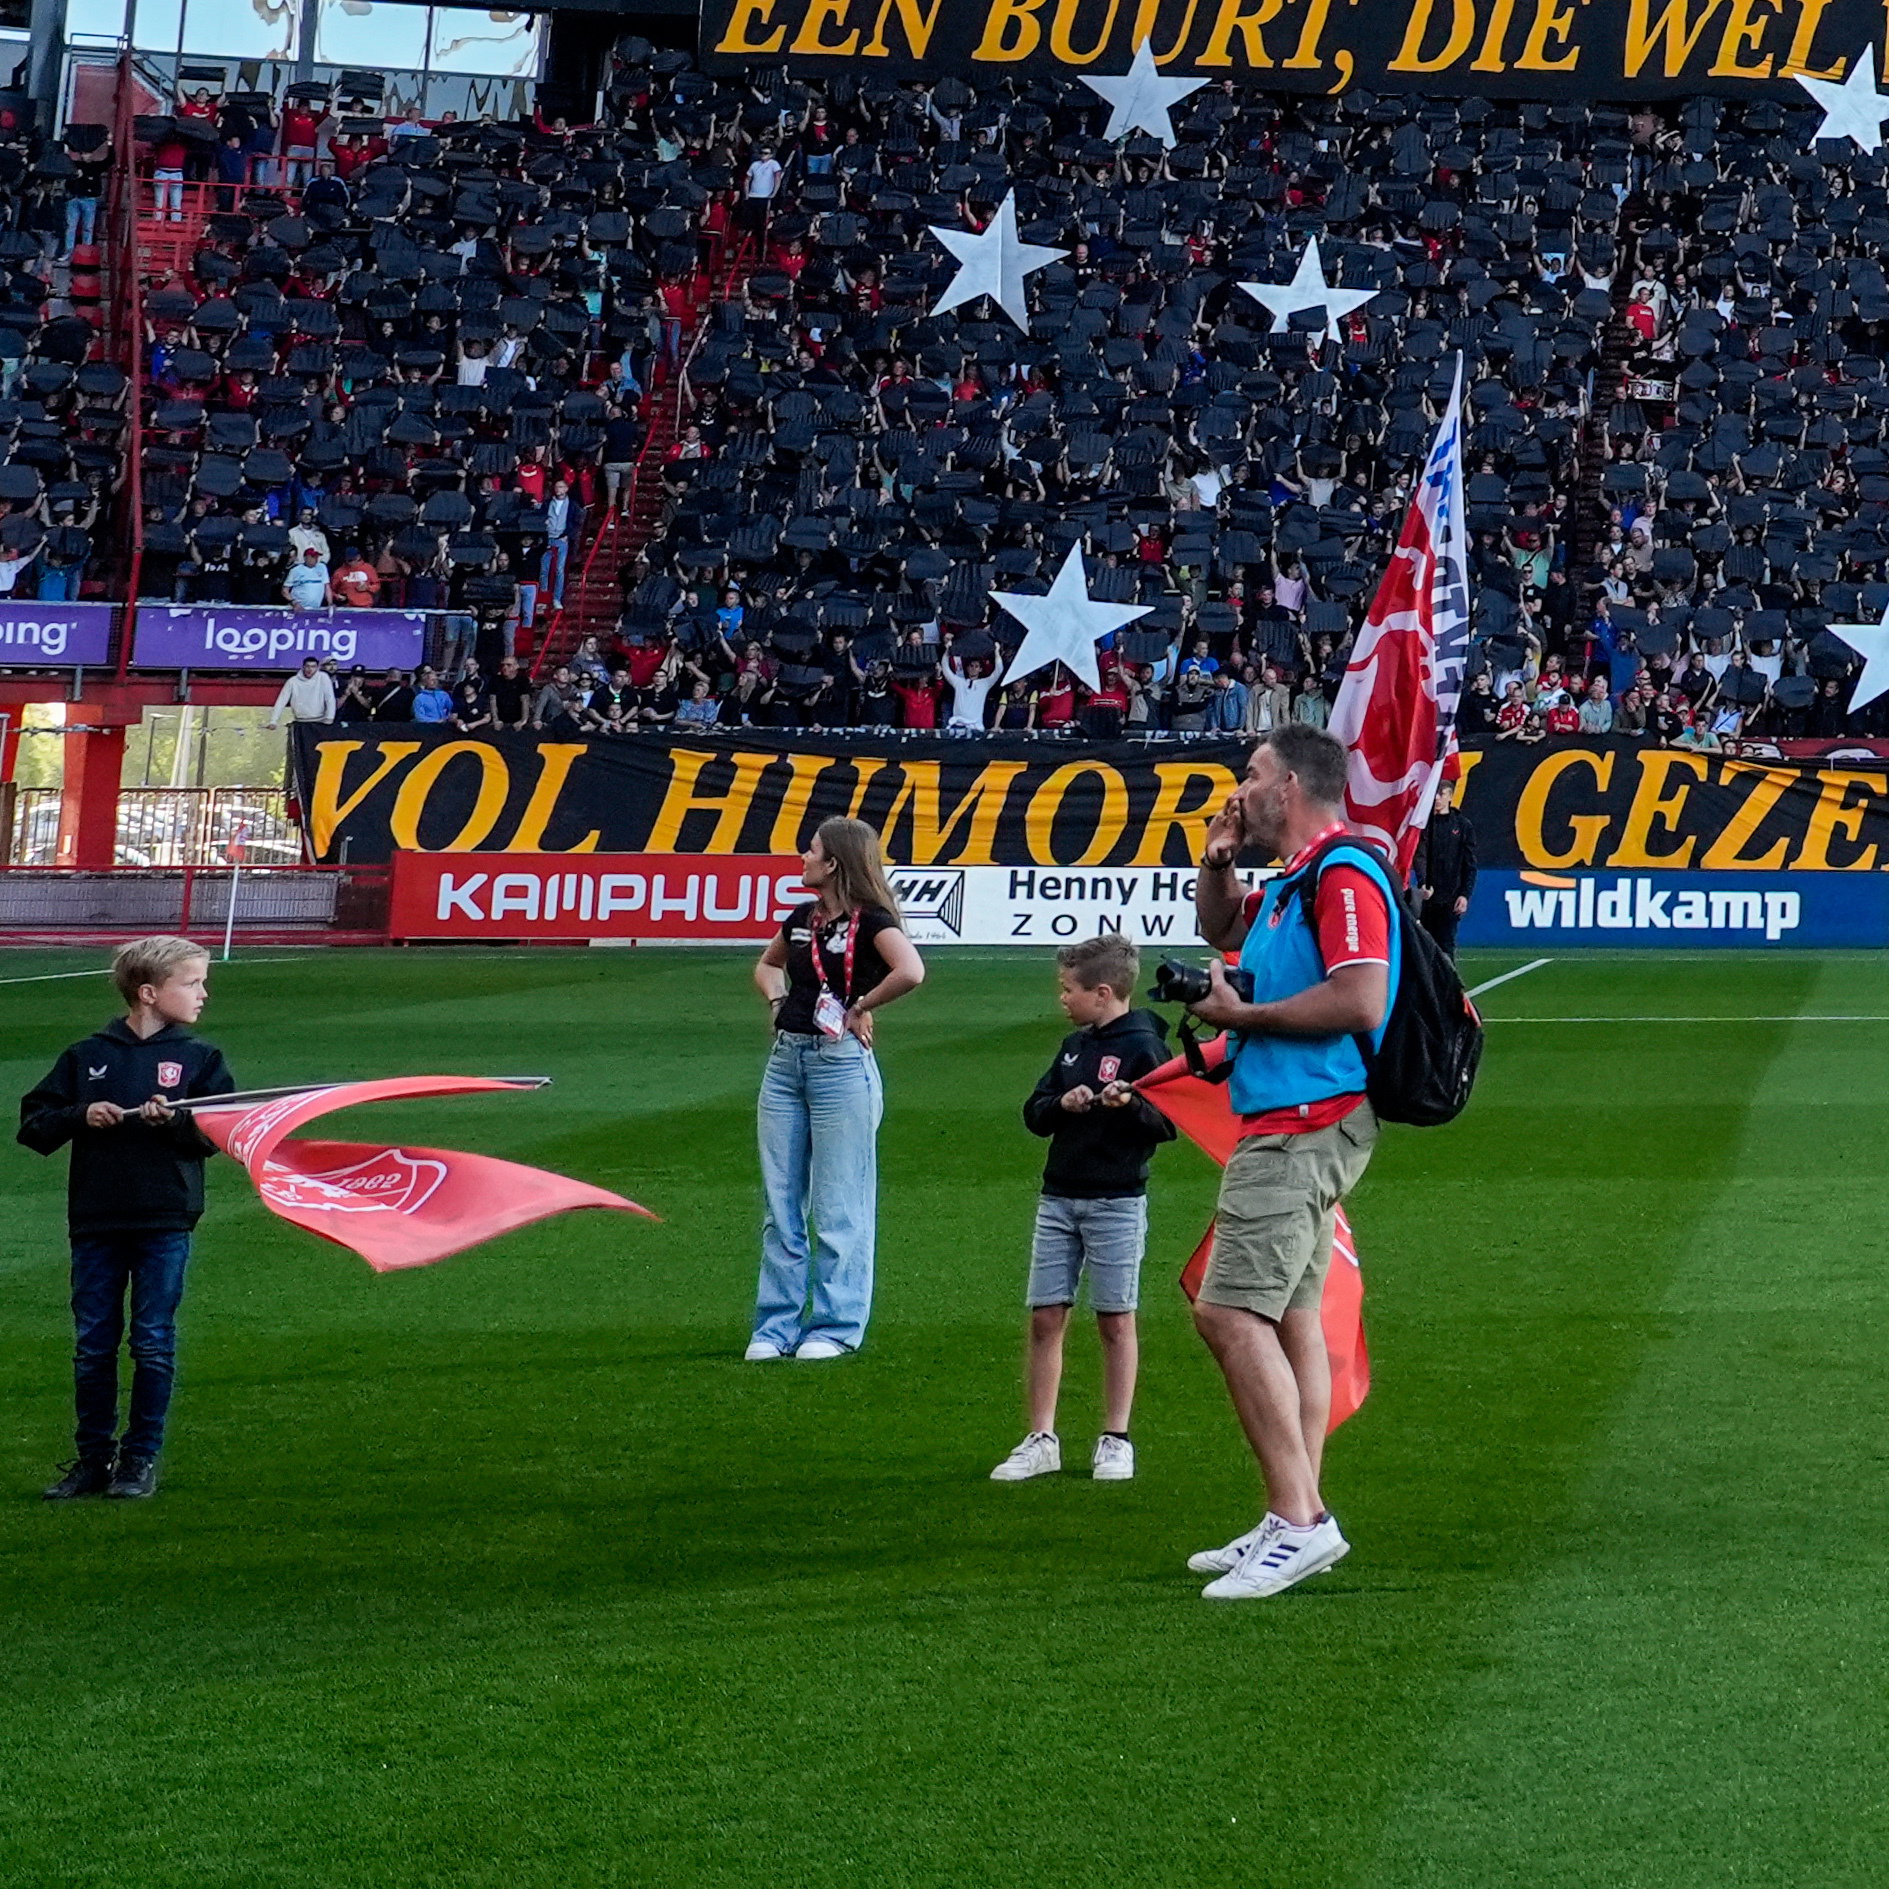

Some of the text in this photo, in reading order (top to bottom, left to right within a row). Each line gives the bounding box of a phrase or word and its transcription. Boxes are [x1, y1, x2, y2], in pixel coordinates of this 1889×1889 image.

[205, 618, 357, 660] looping
[313, 739, 601, 859] VOL
[437, 873, 819, 921] KAMPHUIS
[1009, 869, 1138, 905] Henny
[1505, 878, 1800, 941] wildkamp
[1341, 888, 1360, 953] pure energie
